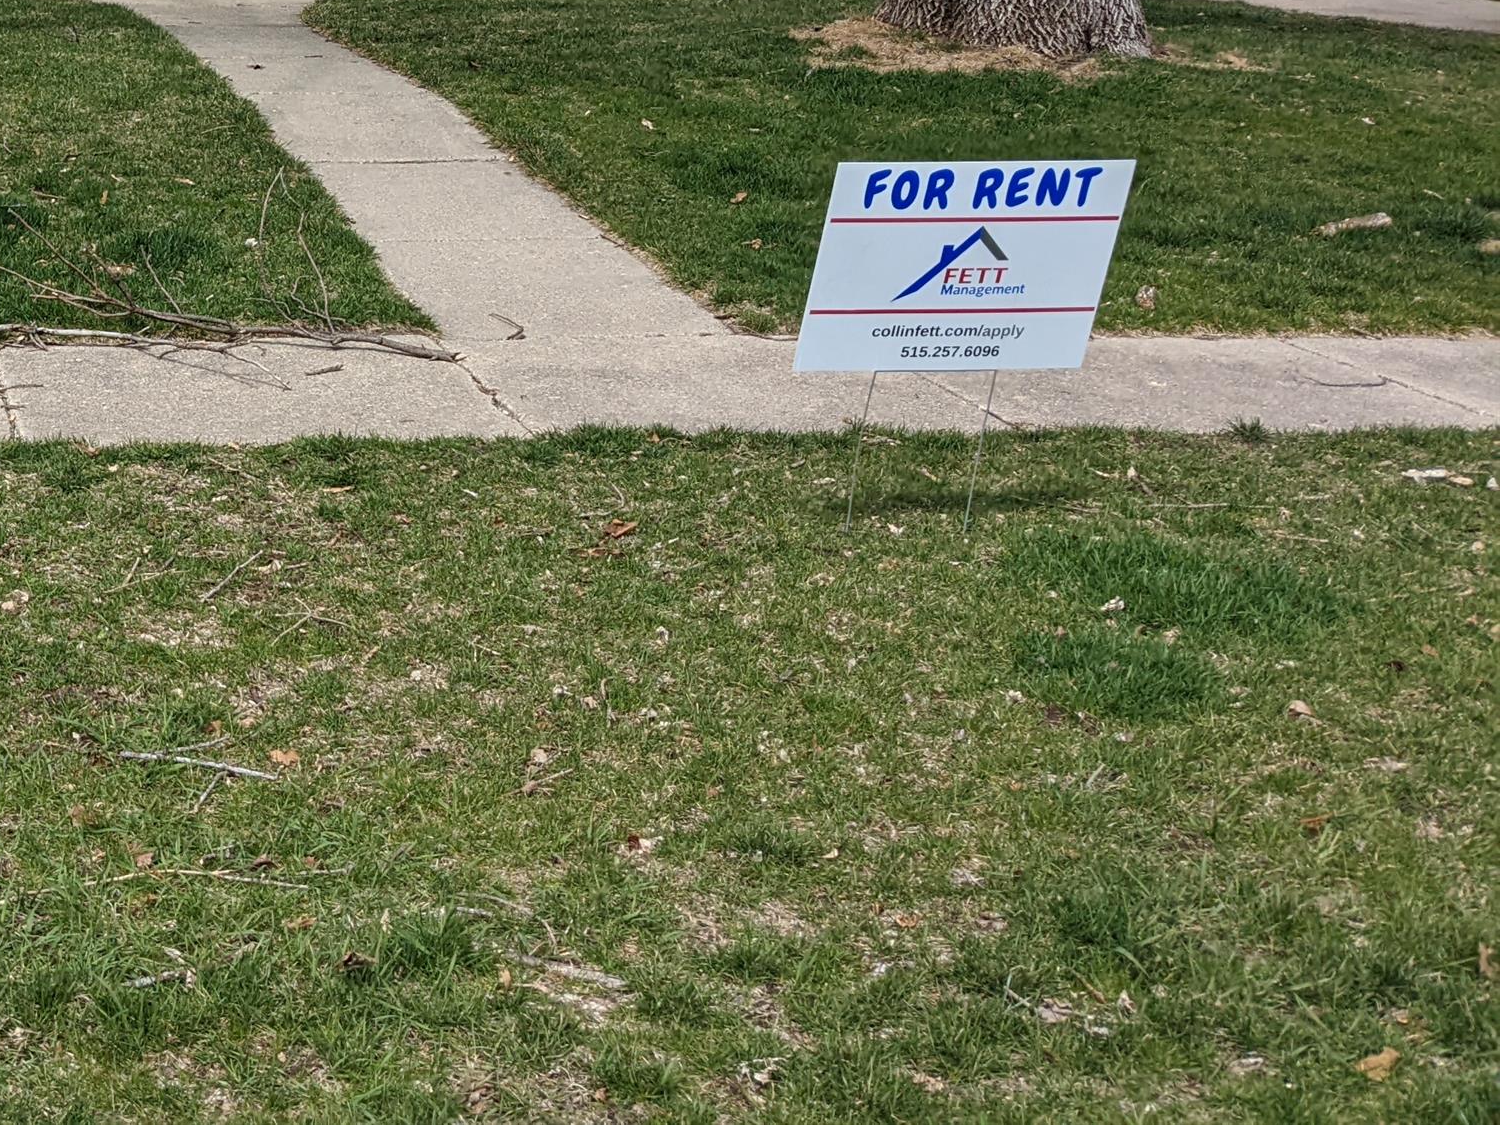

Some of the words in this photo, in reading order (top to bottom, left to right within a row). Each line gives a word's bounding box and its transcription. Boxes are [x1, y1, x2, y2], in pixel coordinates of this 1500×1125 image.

[863, 168, 955, 210] FOR
[972, 166, 1104, 209] RENT
[943, 267, 1009, 284] FETT
[940, 284, 1026, 298] Management
[871, 324, 1025, 340] collinfett.com/apply
[900, 345, 1000, 358] 515.257.6096
